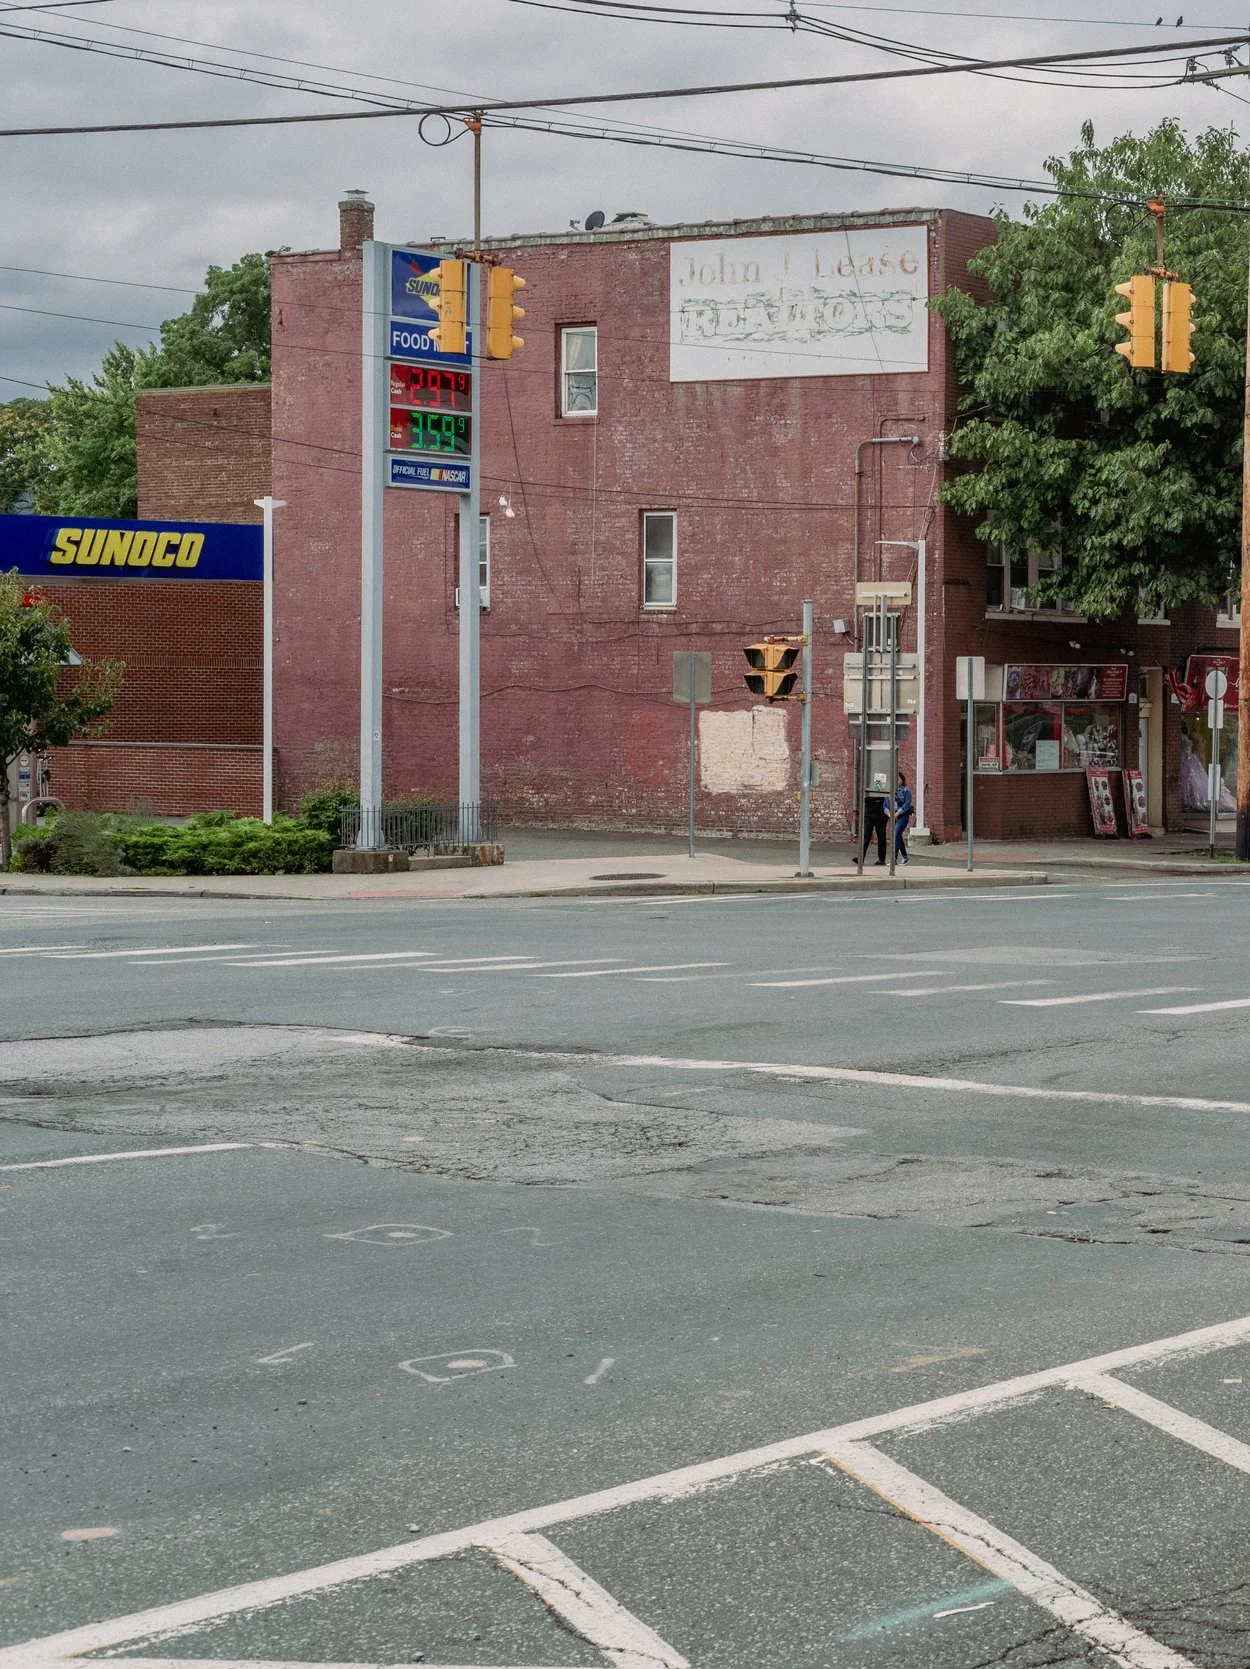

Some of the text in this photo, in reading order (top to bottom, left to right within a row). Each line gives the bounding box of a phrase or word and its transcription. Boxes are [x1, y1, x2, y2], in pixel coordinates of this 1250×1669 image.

[680, 251, 761, 287] John
[813, 246, 919, 281] Lease
[393, 331, 429, 350] FOOD
[391, 387, 402, 395] Cash
[391, 431, 402, 439] Cash
[393, 464, 467, 483] OFFICIAL FUEL NASCAR
[50, 528, 205, 568] SUNOCO
